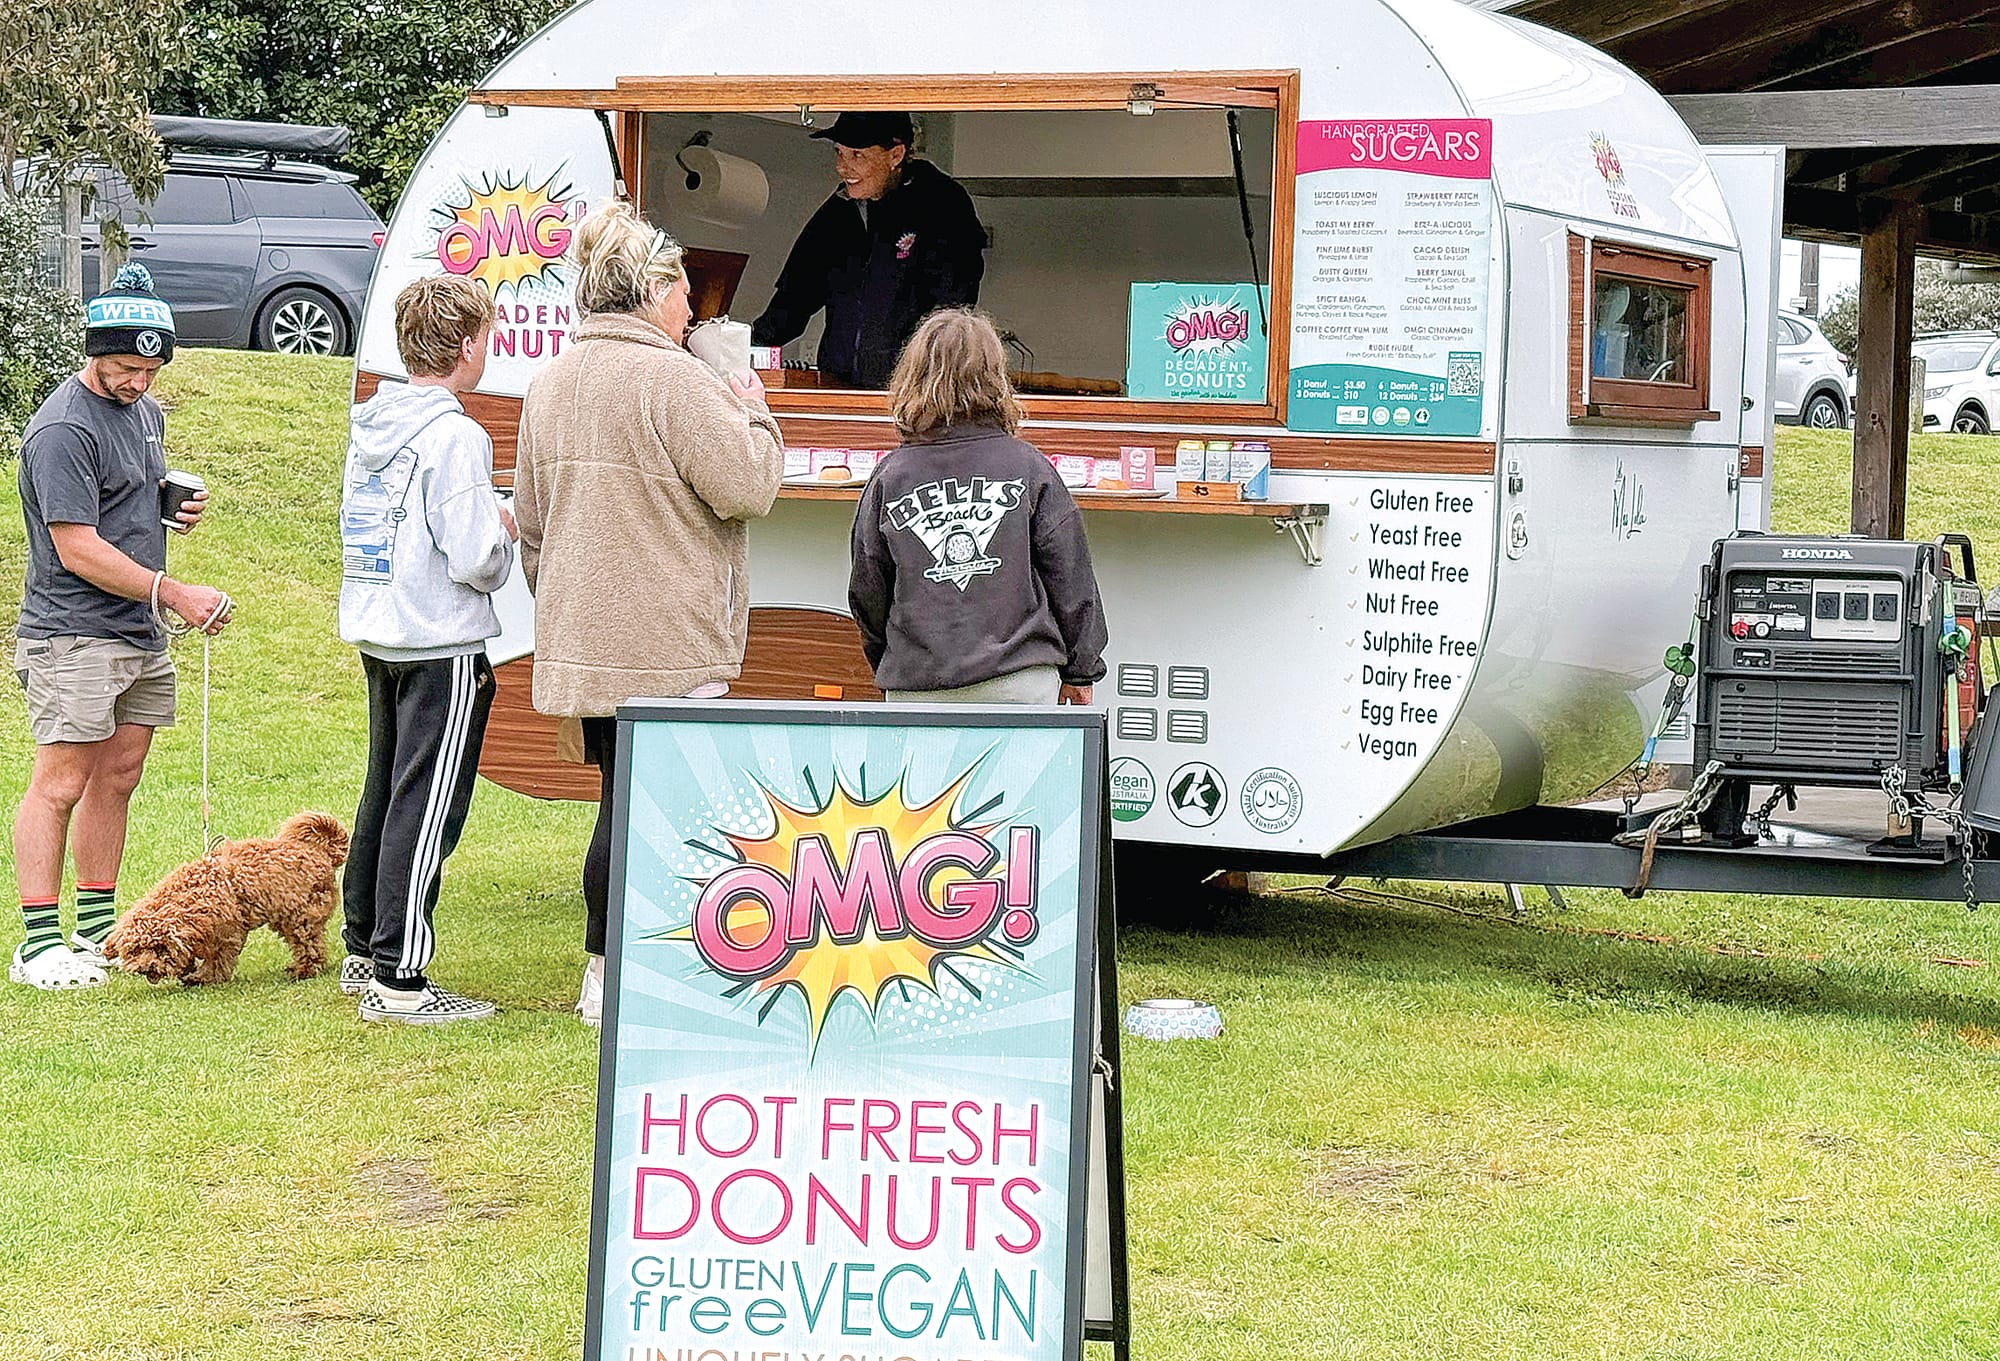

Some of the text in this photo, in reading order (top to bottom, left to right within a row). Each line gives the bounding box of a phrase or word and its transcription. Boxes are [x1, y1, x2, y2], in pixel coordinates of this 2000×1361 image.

[1321, 124, 1431, 139] HANDCRAFTED
[1350, 131, 1481, 162] SUGARS
[1413, 246, 1443, 254] CACAO
[1166, 310, 1249, 350] OMG!
[1164, 372, 1247, 389] DONUTS
[1303, 379, 1328, 389] Donut
[1344, 380, 1366, 390] $3.50
[1378, 381, 1385, 390] 6
[1390, 381, 1418, 391] Donuts
[1296, 390, 1359, 400] 3 Donuts $10
[1379, 391, 1388, 401] 12
[1390, 392, 1418, 401] Donuts
[1369, 488, 1473, 513] Gluten Free
[921, 504, 993, 531] Beach
[1369, 523, 1462, 548] Yeast Free
[1781, 548, 1854, 560] HONDA
[1368, 558, 1469, 583] Wheat Free
[1366, 592, 1439, 616] Nut Free
[1362, 630, 1477, 657] Sulphite Free
[1362, 664, 1452, 692] Dairy Free
[1361, 699, 1438, 726] Egg Free
[1359, 733, 1417, 761] Vegan
[1111, 791, 1148, 800] USTRALIA
[1111, 801, 1148, 811] ERTIFIED
[691, 824, 1040, 982] OMG!
[641, 1093, 1038, 1167] HOT FRESH
[633, 1166, 1042, 1254] DONUTS
[630, 1255, 785, 1292] GLUTEN
[630, 1260, 1037, 1342] free VEGAN
